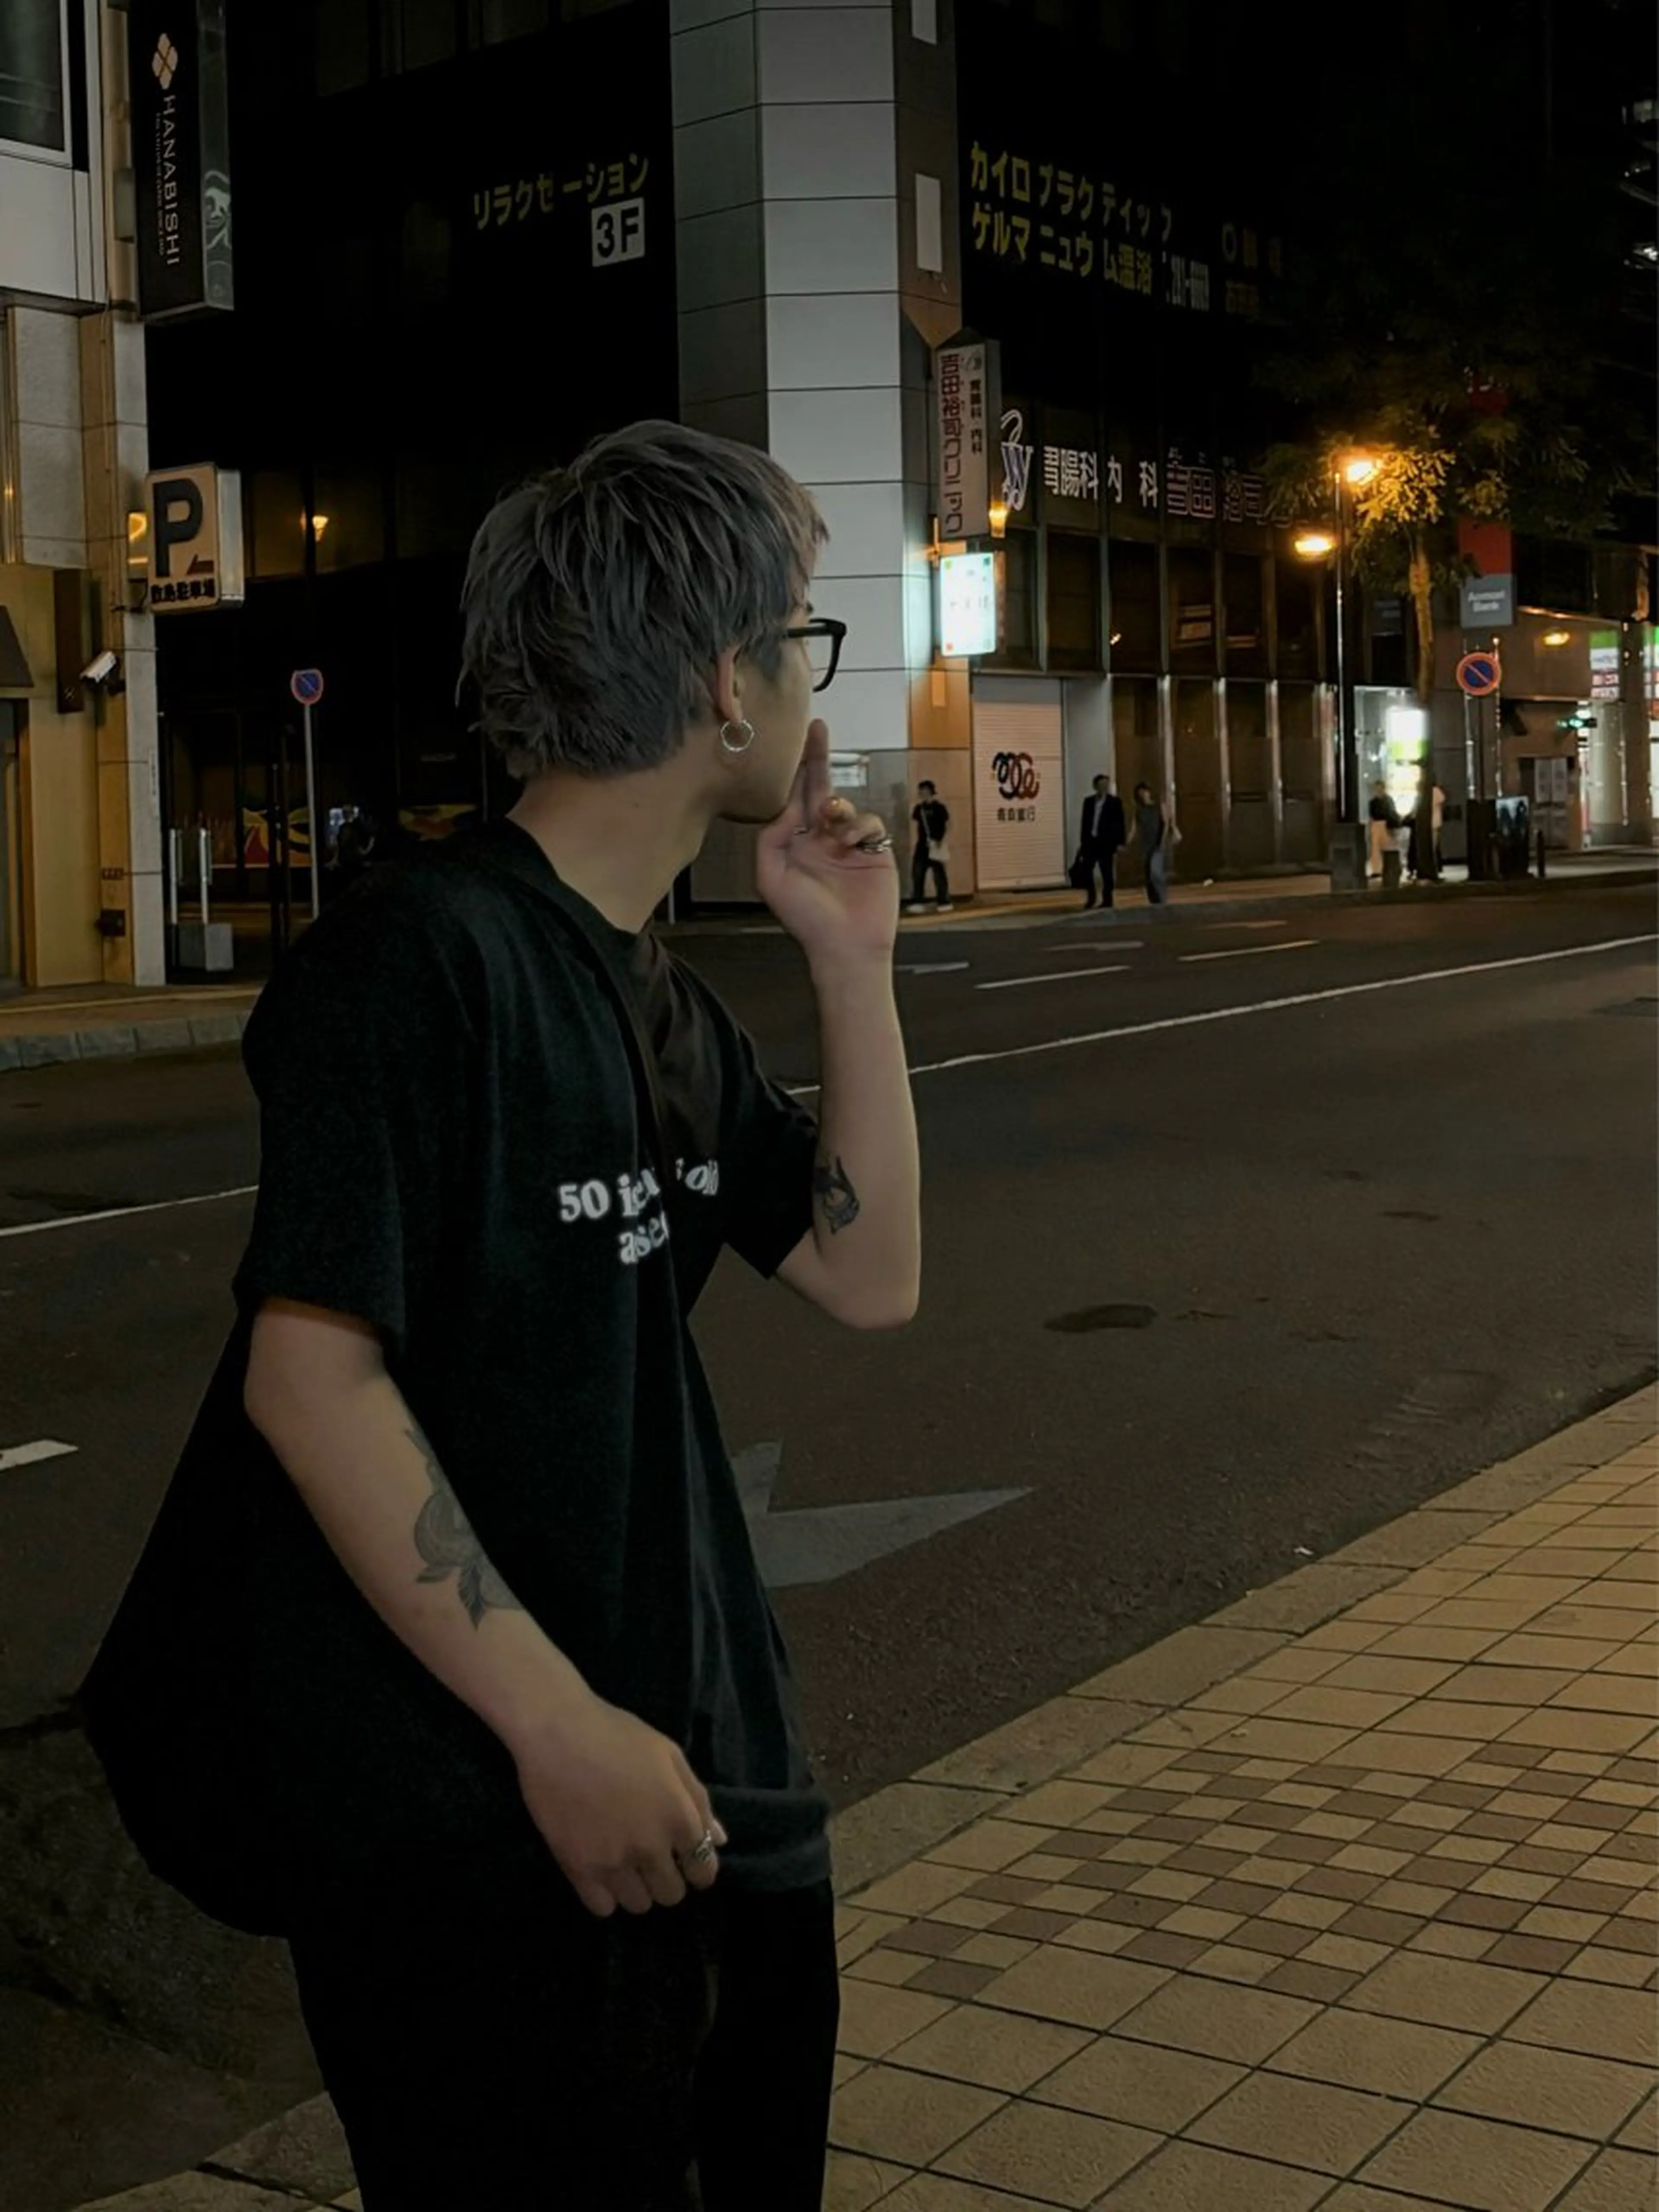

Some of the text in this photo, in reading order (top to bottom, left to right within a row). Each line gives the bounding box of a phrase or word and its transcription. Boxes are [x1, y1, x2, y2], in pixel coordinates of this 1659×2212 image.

[162, 94, 180, 265] HANABISHI
[474, 152, 648, 230] リラクセーション
[597, 207, 639, 257] 3F
[153, 478, 203, 577] P
[558, 1179, 610, 1224] 50
